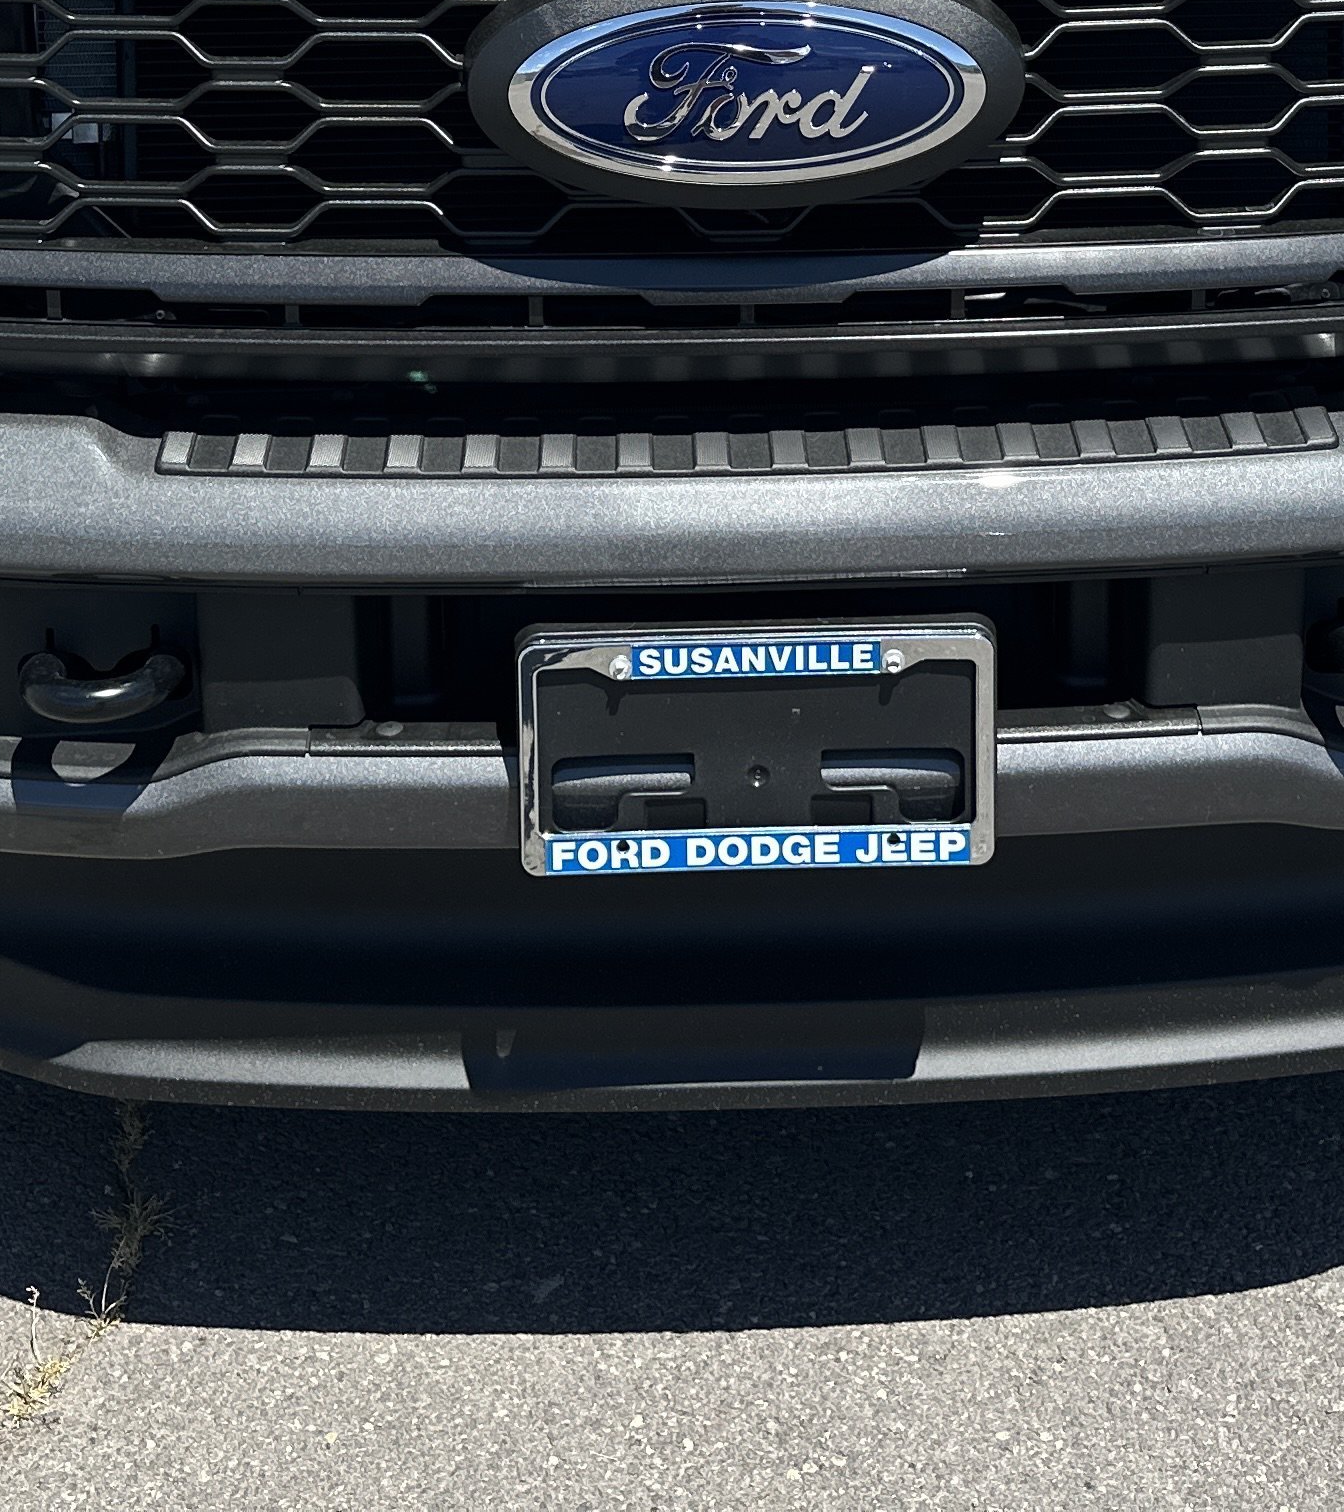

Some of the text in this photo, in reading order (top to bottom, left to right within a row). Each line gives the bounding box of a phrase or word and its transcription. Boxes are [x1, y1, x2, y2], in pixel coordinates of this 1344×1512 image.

[624, 41, 870, 142] Ford
[638, 643, 875, 676] SUSANVILLE
[551, 831, 967, 871] FORD DODGE JEEP
